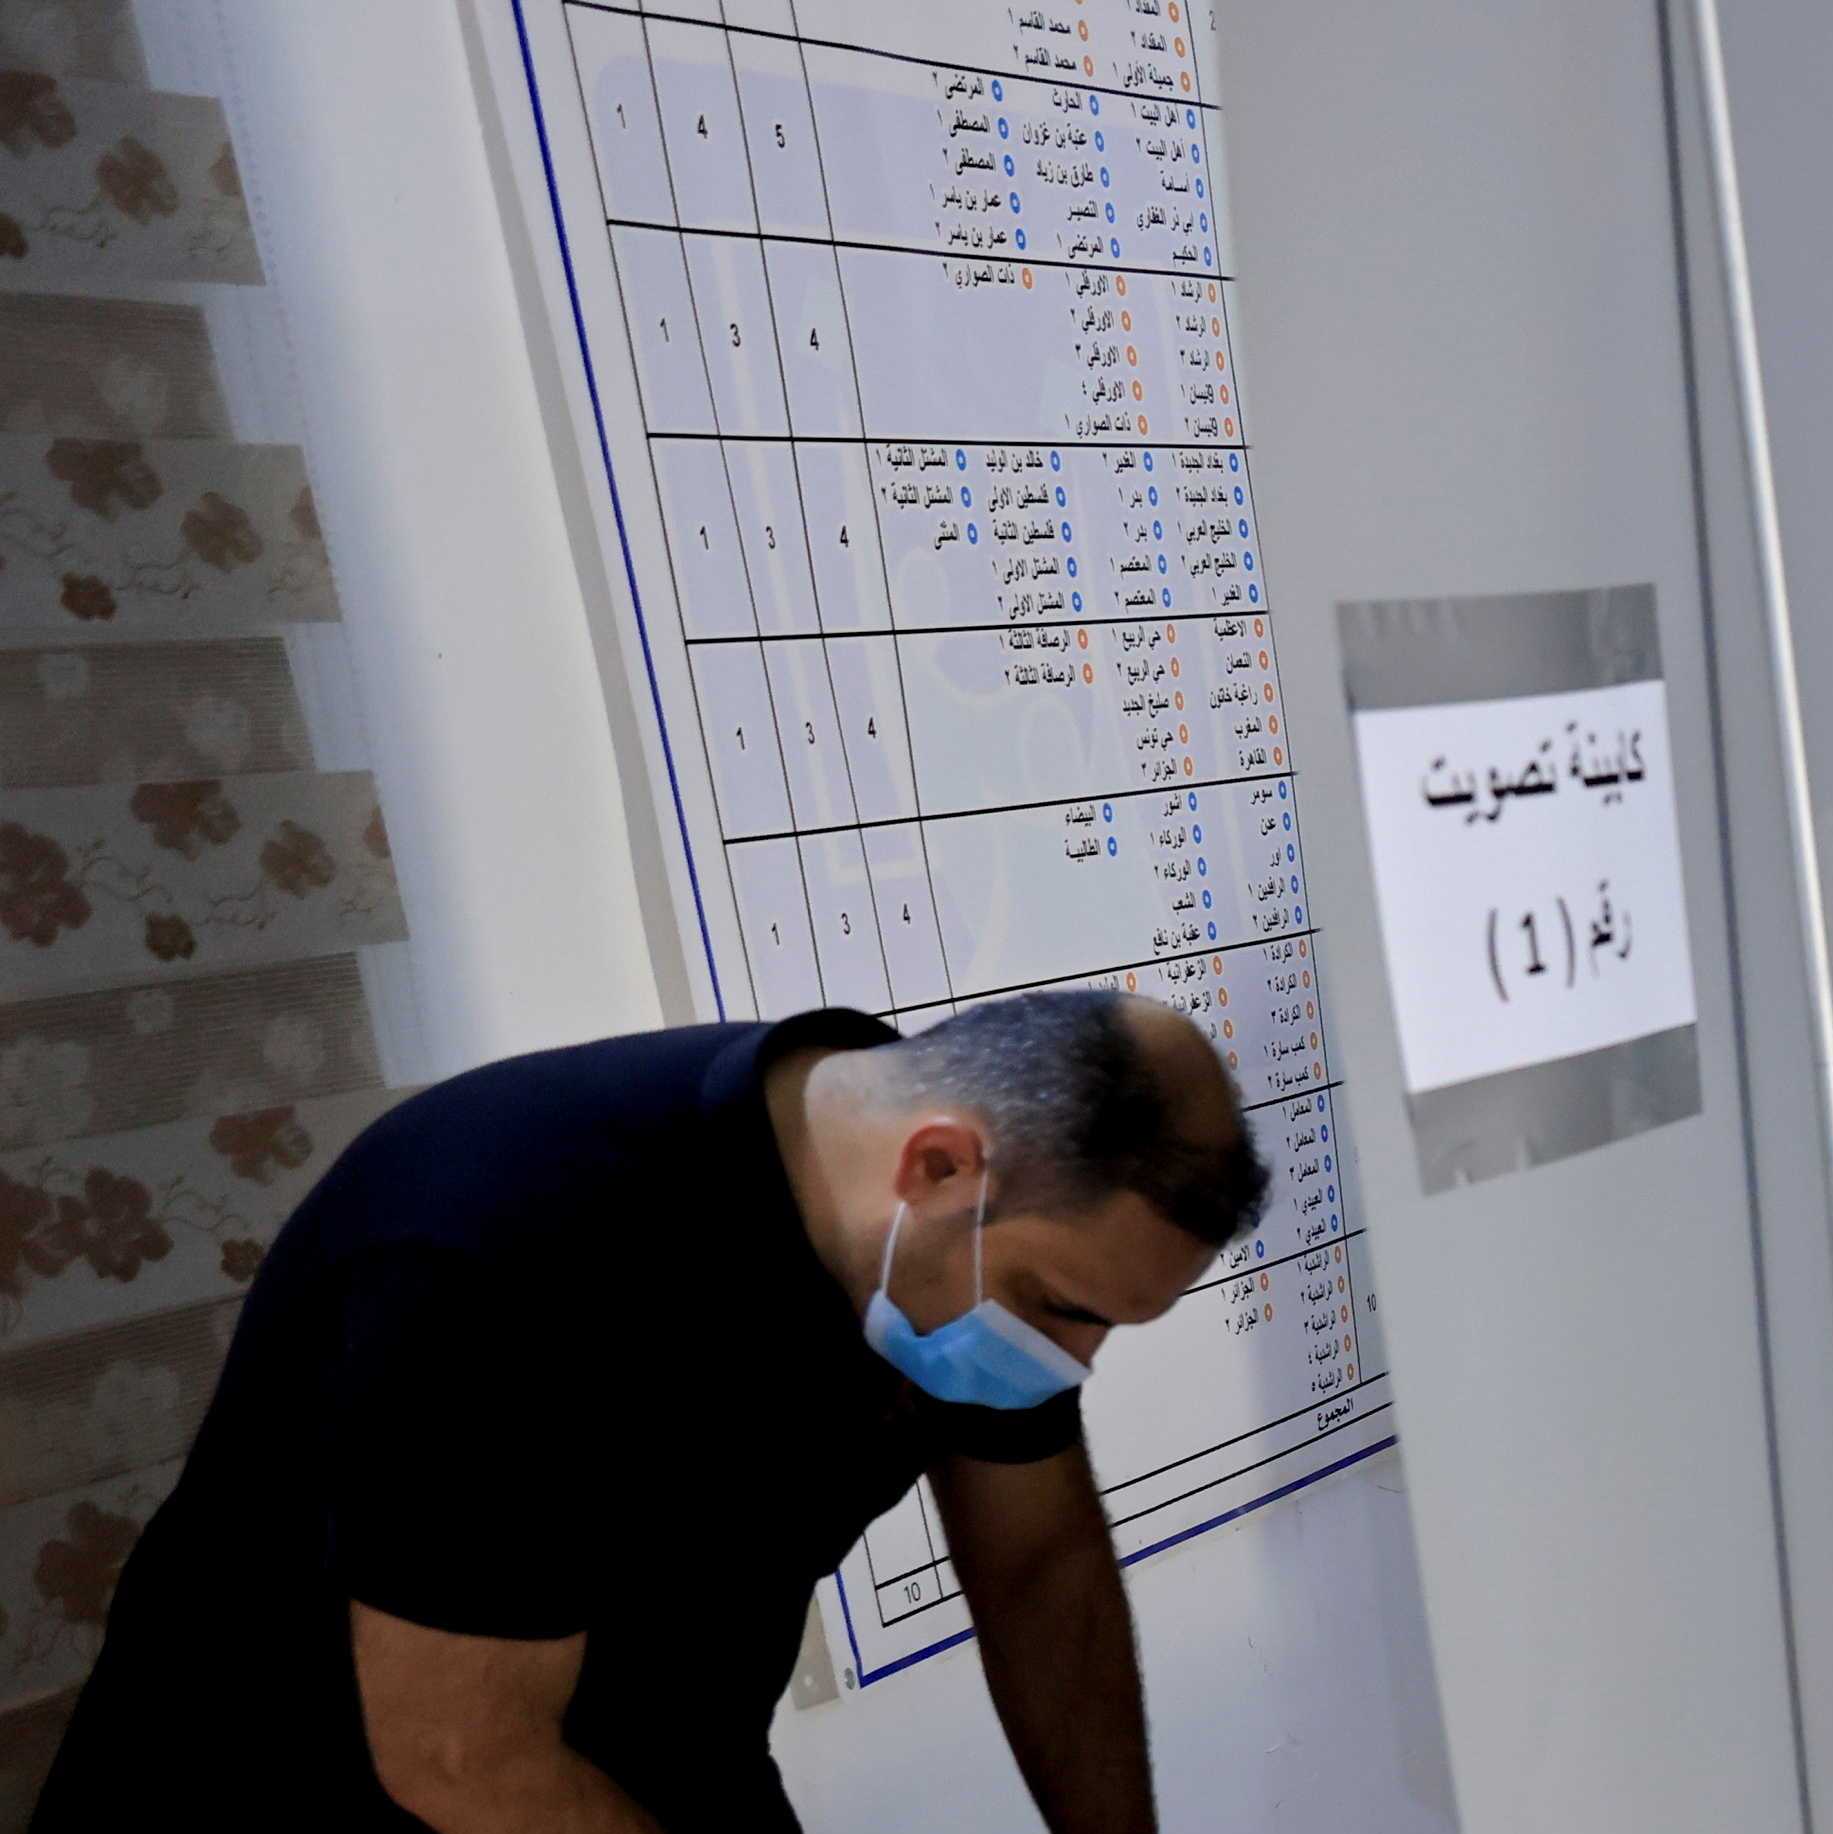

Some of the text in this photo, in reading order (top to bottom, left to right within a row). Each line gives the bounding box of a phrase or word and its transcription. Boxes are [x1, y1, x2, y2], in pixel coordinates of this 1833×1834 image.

[1422, 740, 1557, 825] تصويت
[1487, 880, 1630, 1002] رقم (1)
